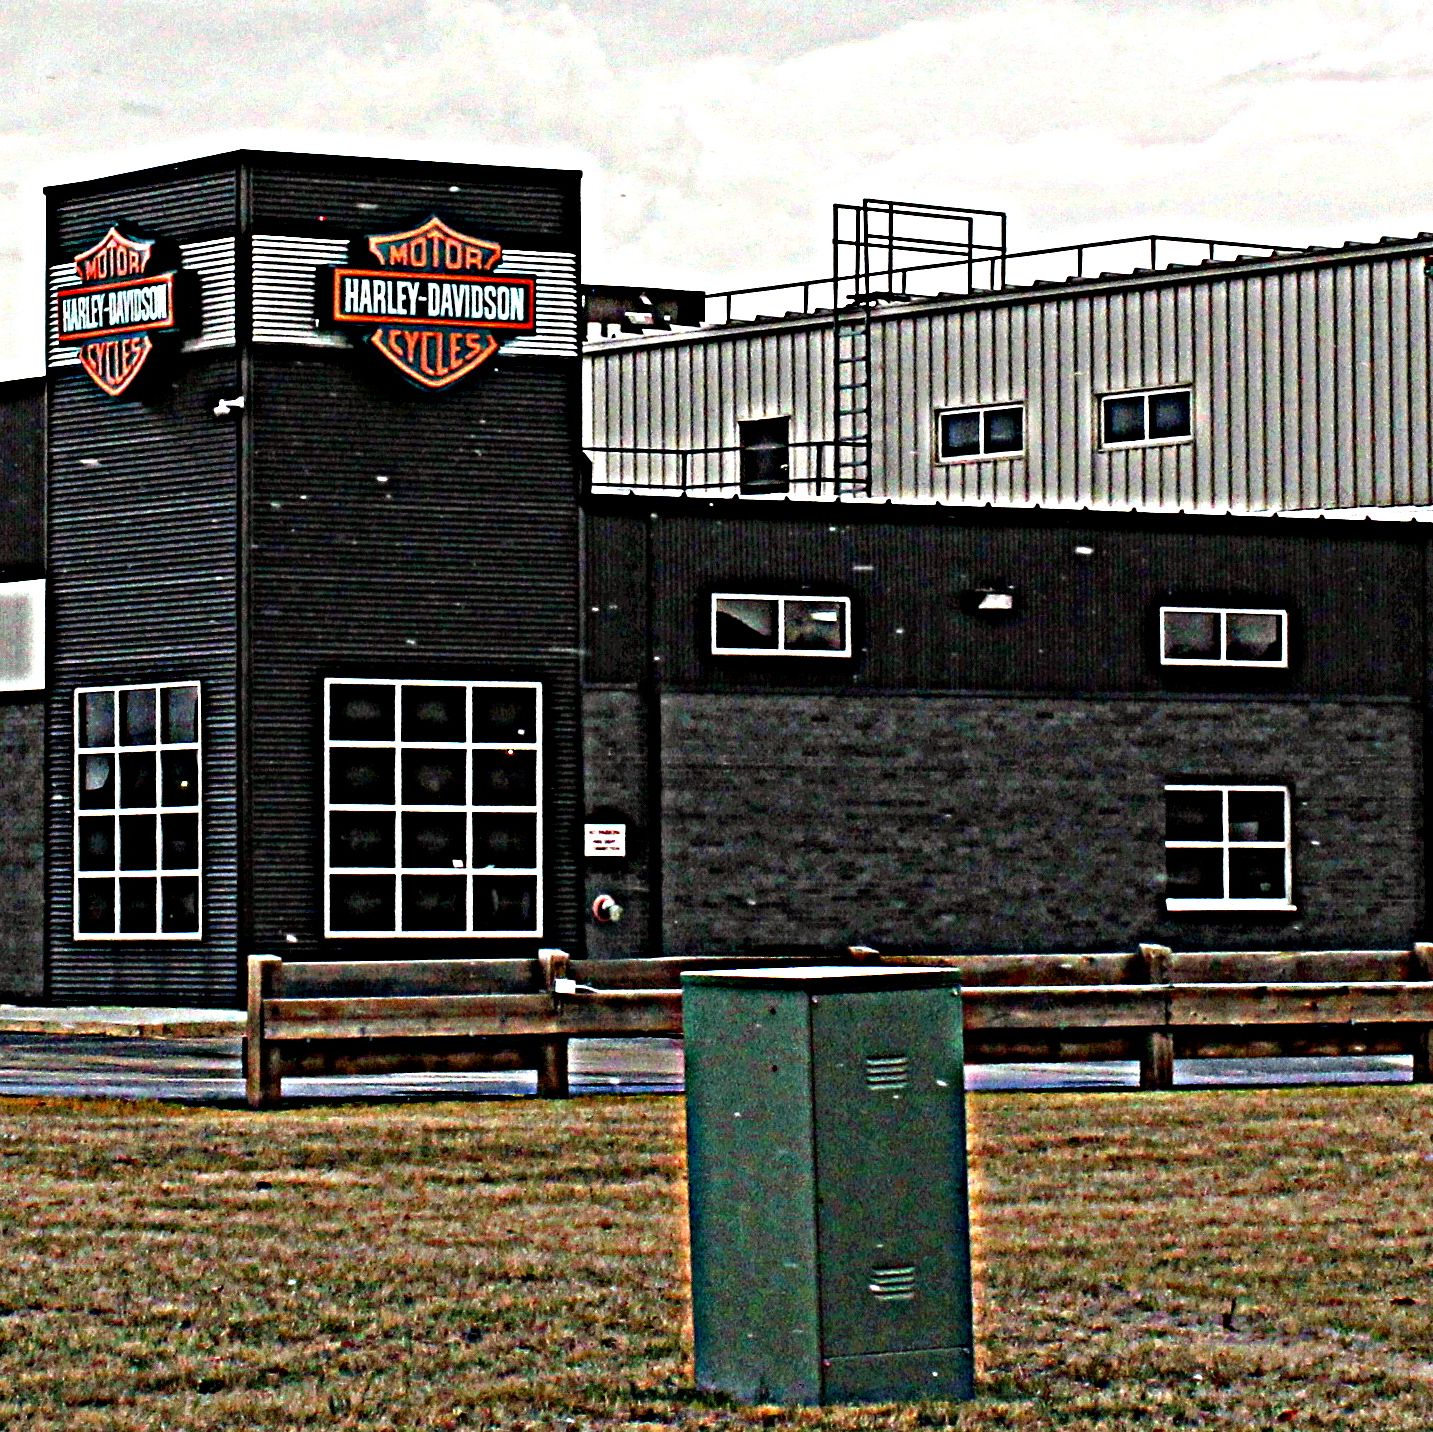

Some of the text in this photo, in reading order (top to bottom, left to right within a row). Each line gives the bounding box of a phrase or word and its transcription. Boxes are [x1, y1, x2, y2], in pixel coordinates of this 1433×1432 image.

[85, 239, 140, 280] MOTOR
[389, 230, 481, 269] MOTOR
[63, 283, 167, 332] HARLEY-DAVIDSON
[344, 277, 525, 321] HARLEY-DAVIDSON
[88, 337, 142, 385] CYCLES
[388, 329, 482, 376] CYCLES
